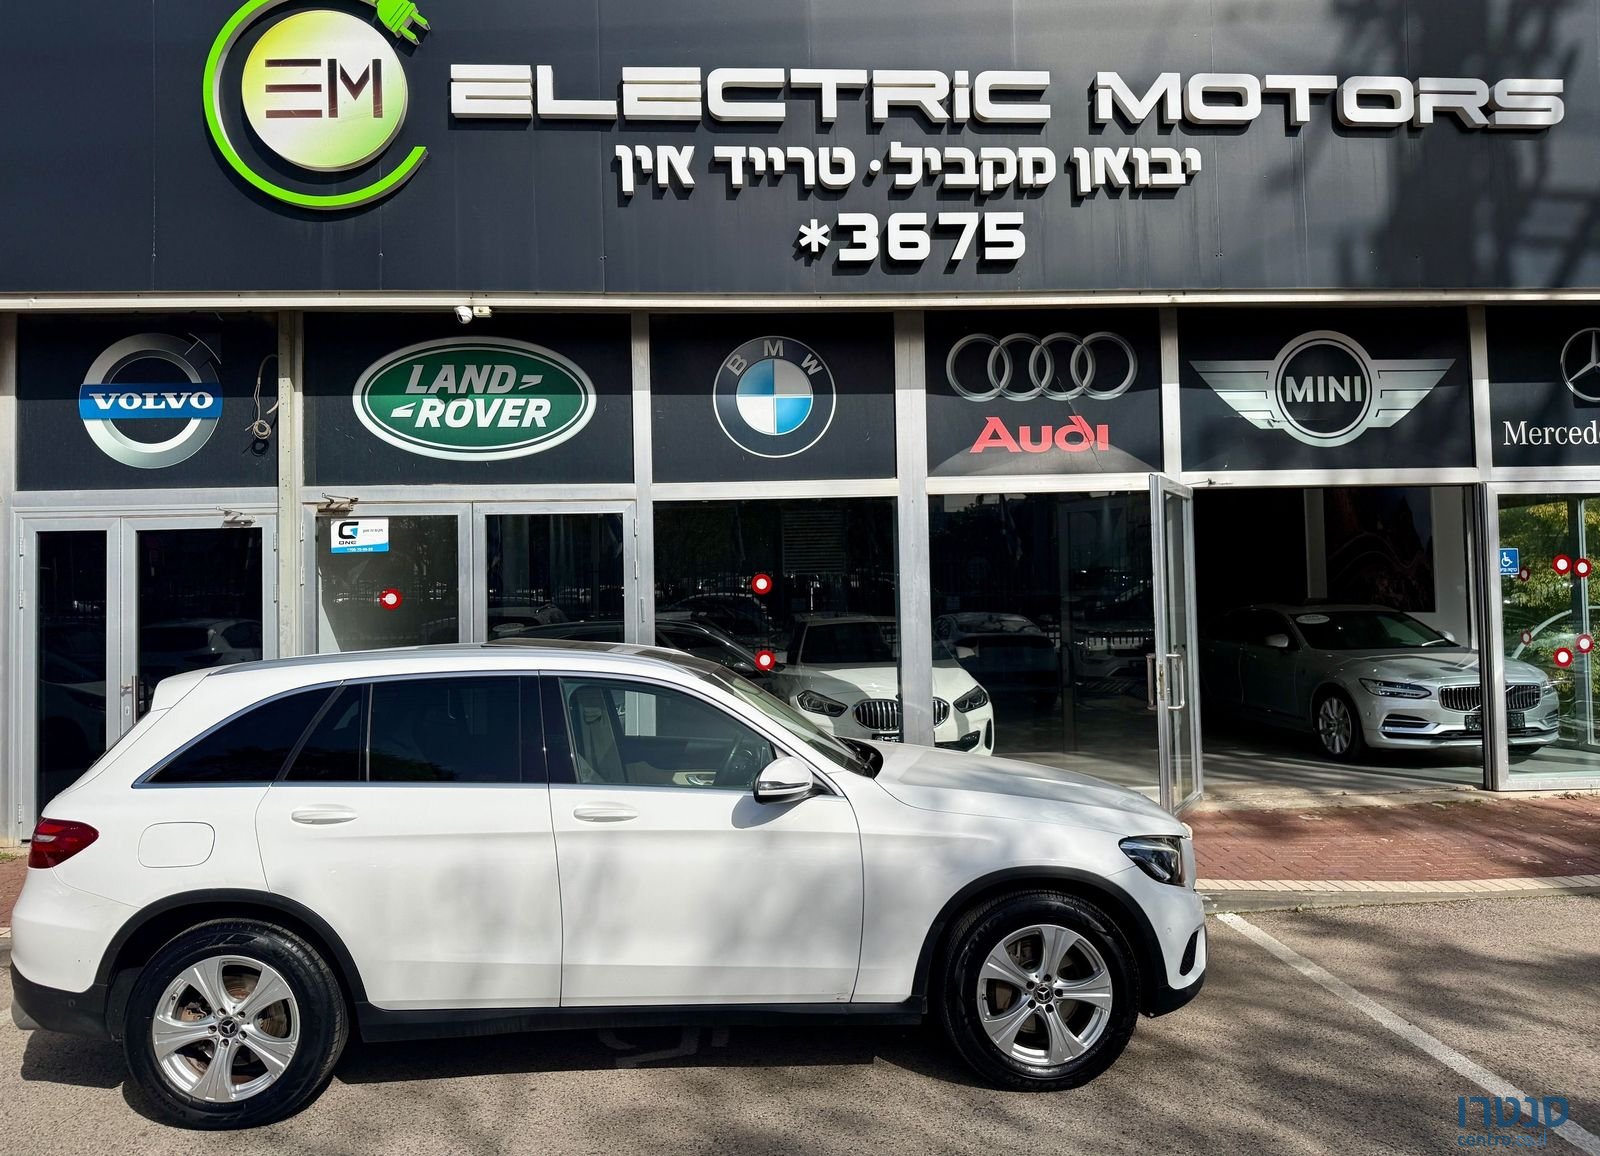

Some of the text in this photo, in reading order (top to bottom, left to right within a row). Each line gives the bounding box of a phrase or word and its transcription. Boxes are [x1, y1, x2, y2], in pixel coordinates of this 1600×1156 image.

[265, 58, 384, 119] EM
[1094, 71, 1565, 130] MOTORS
[615, 141, 1202, 196] יבואן מקביל טרייד אין
[726, 339, 823, 377] BMW
[405, 364, 517, 395] LAND
[1285, 375, 1363, 403] MINI
[88, 391, 214, 410] VOLVO
[414, 398, 551, 428] ROVER
[969, 415, 1110, 453] Audi
[1502, 420, 1600, 446] Merced
